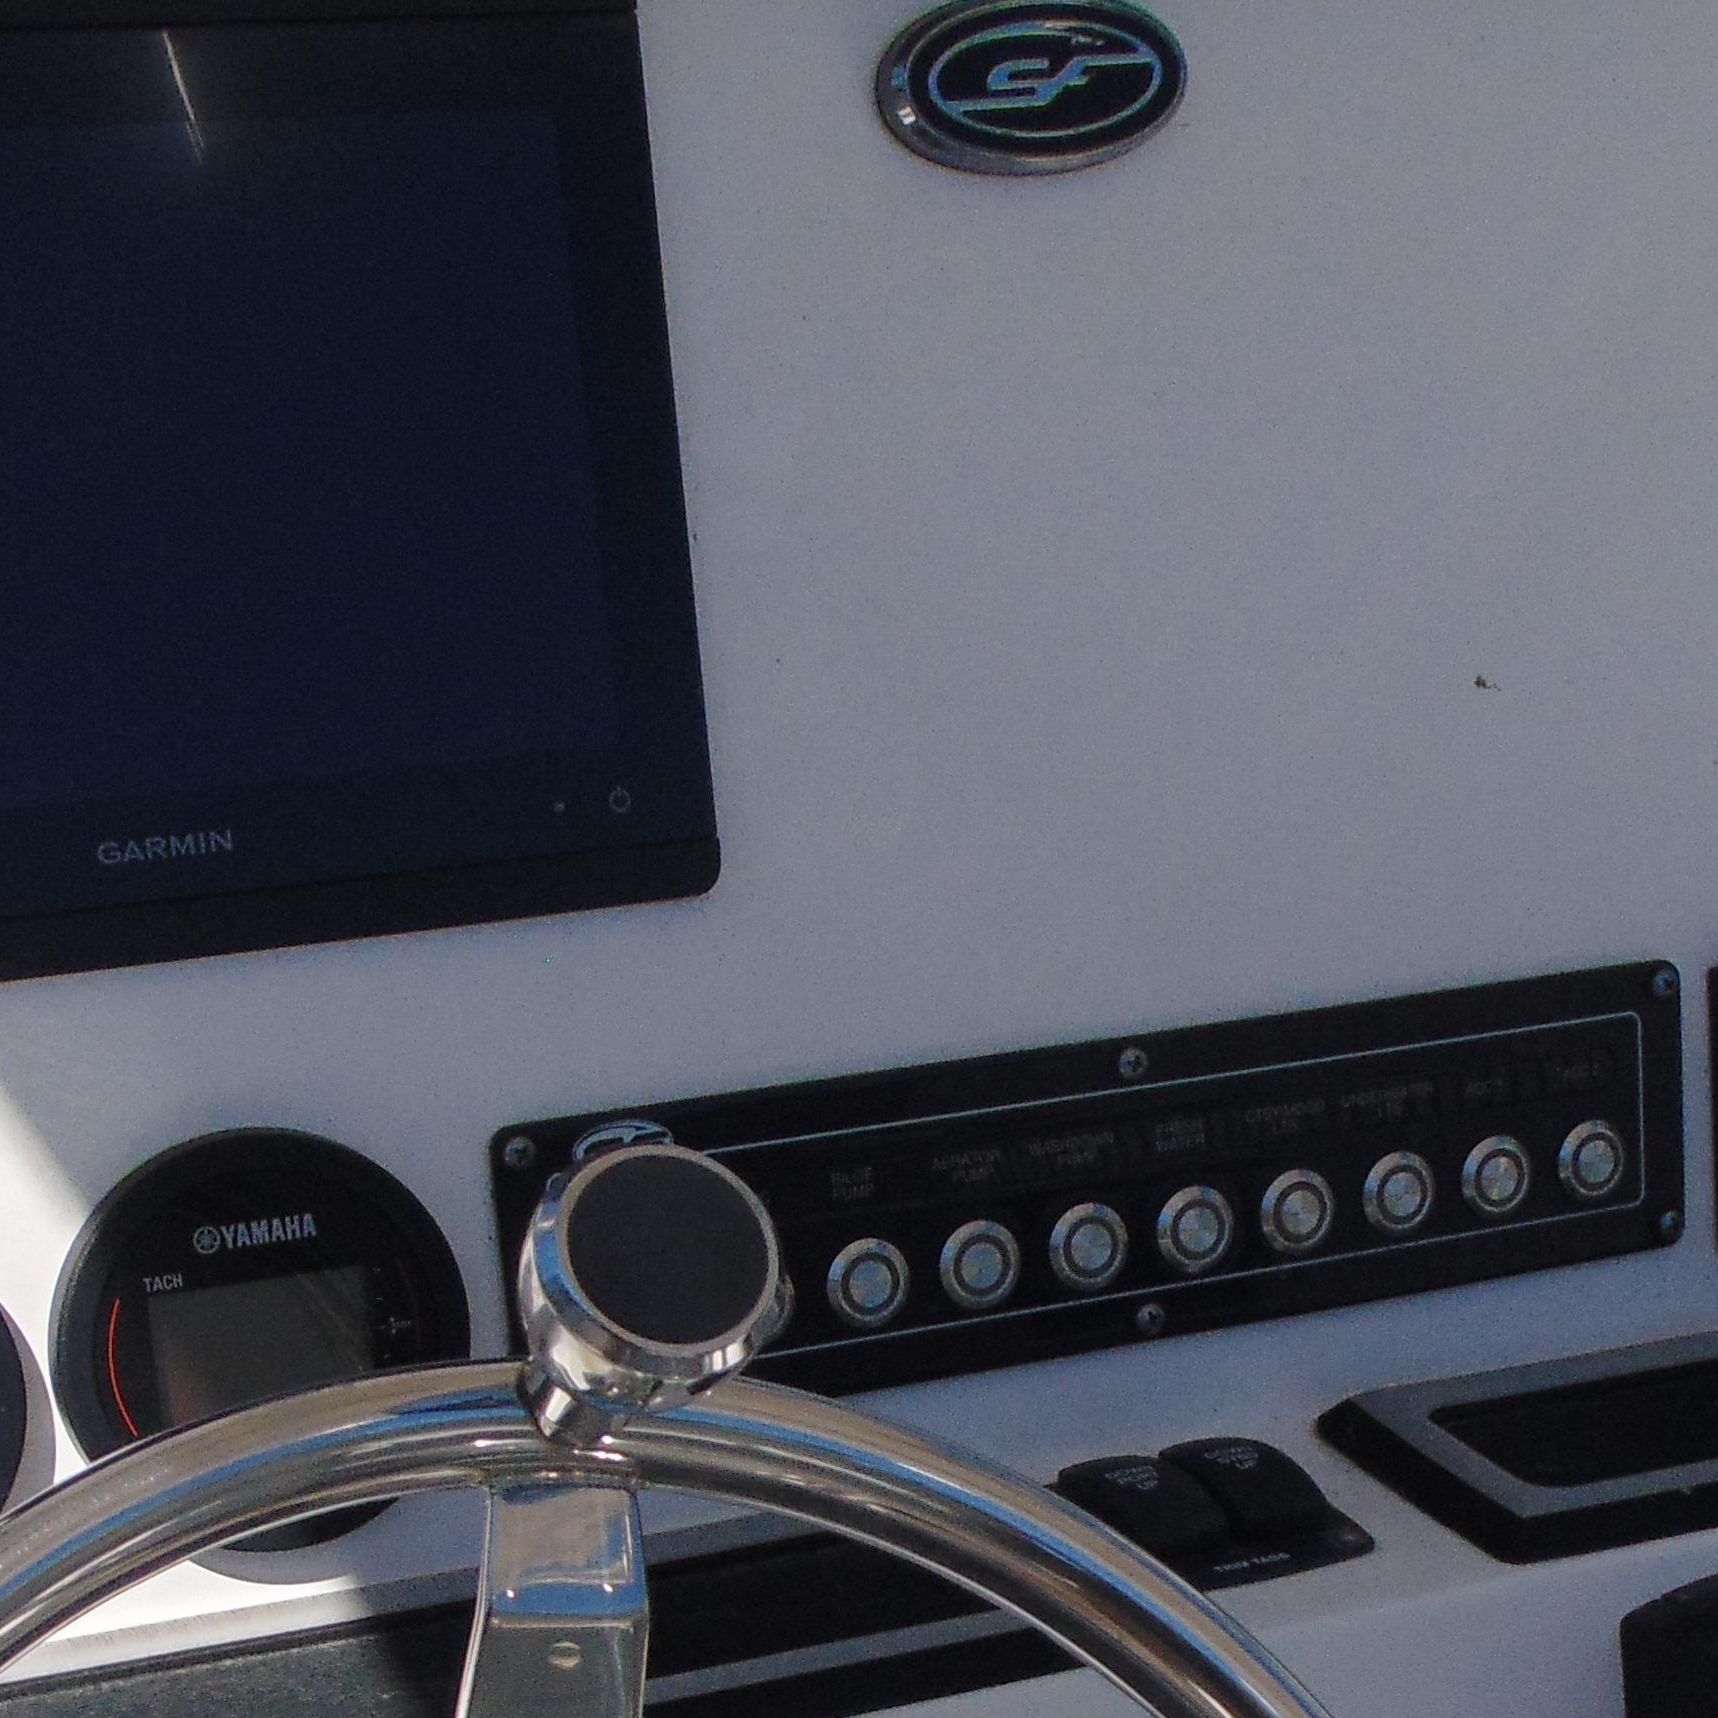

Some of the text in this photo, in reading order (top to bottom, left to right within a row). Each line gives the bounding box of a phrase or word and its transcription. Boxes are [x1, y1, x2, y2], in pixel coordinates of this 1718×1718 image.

[97, 830, 232, 865] GARMIN
[220, 1213, 317, 1250] YAMAHA
[143, 1273, 183, 1293] TACH
